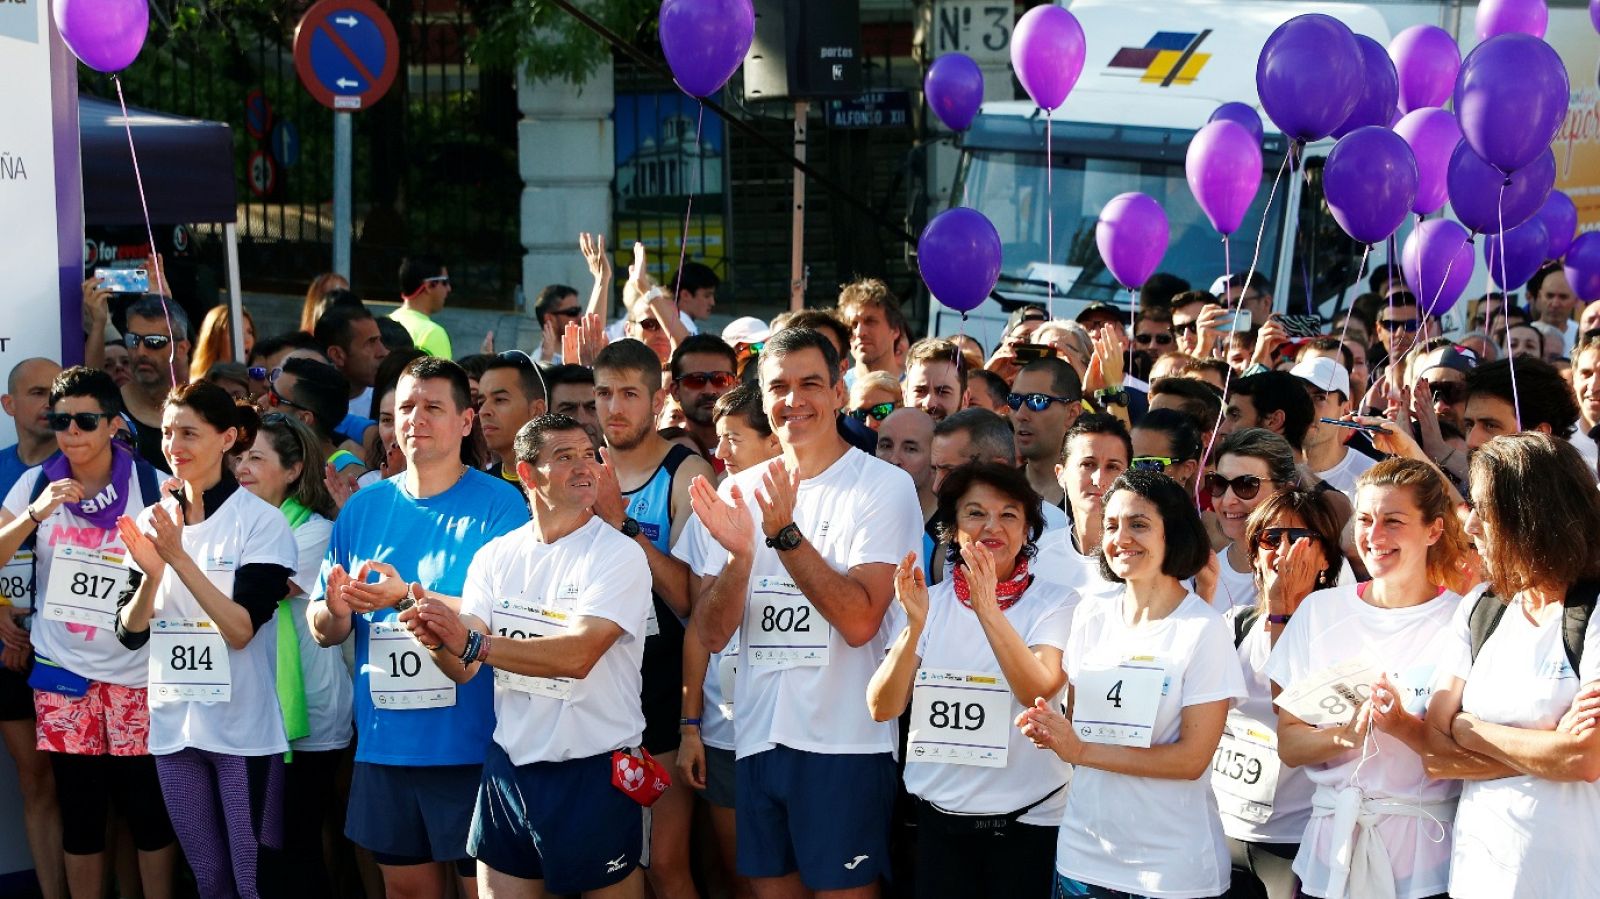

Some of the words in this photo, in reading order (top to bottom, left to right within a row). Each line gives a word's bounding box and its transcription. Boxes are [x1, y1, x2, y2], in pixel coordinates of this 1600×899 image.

[983, 6, 1009, 51] 3
[835, 110, 882, 125] ALFONSO
[80, 483, 119, 514] 8M
[70, 572, 116, 600] 817
[761, 605, 810, 632] 802
[170, 645, 213, 671] 814
[388, 650, 422, 678] 10
[1106, 679, 1123, 708] 4
[929, 700, 986, 731] 819
[1213, 746, 1263, 785] 1159
